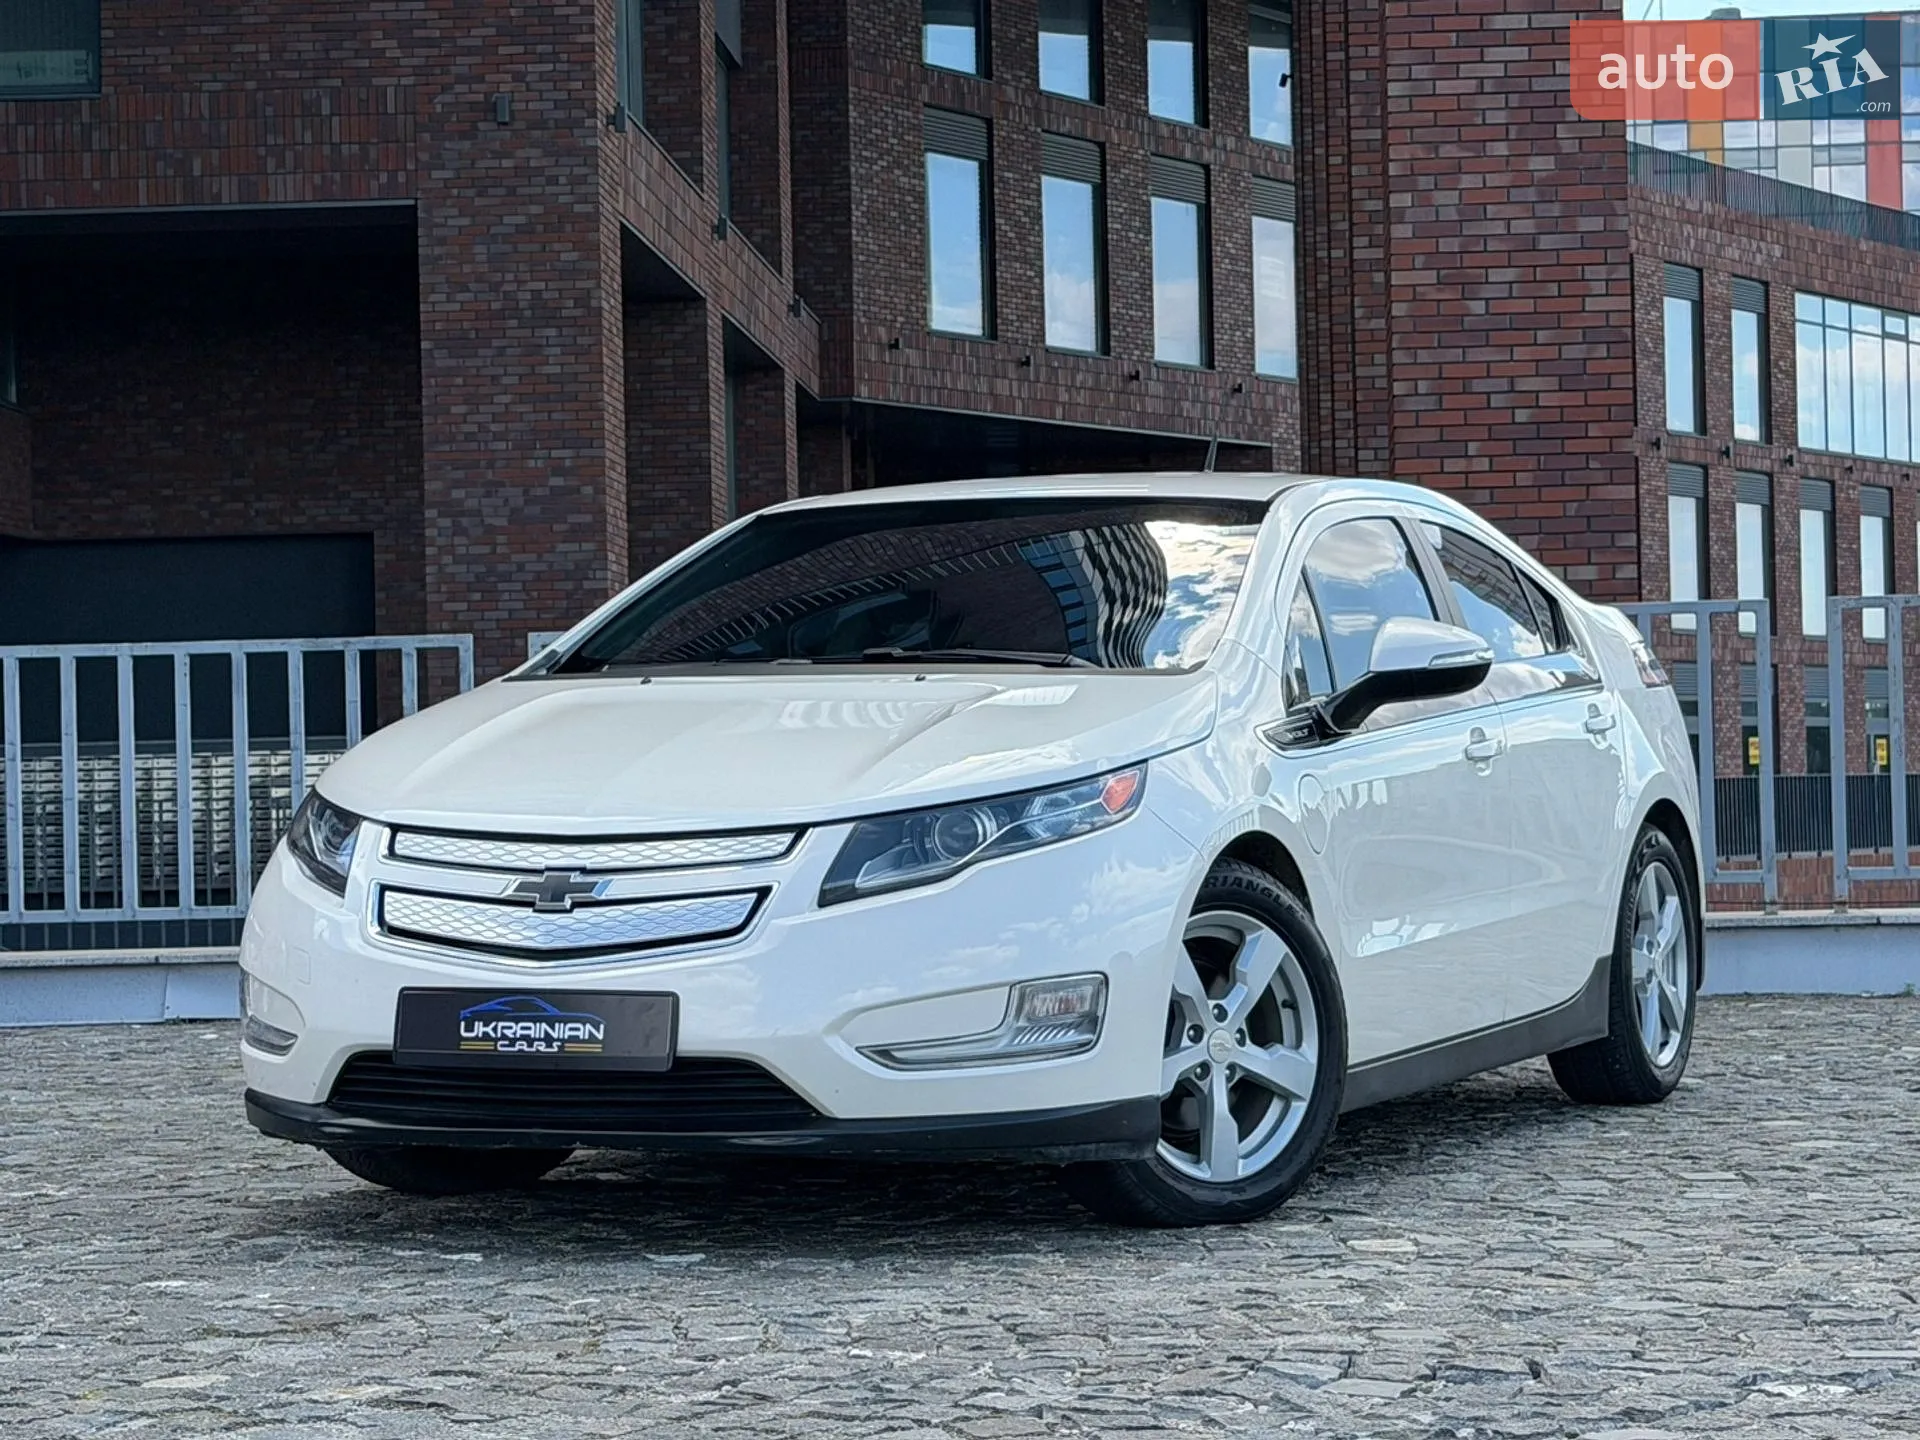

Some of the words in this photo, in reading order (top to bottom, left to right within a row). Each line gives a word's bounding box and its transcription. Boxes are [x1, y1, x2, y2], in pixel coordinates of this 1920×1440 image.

[1201, 874, 1299, 915] RIANGLE
[459, 1020, 605, 1040] UKRAINIAN
[496, 1040, 562, 1052] CARS
